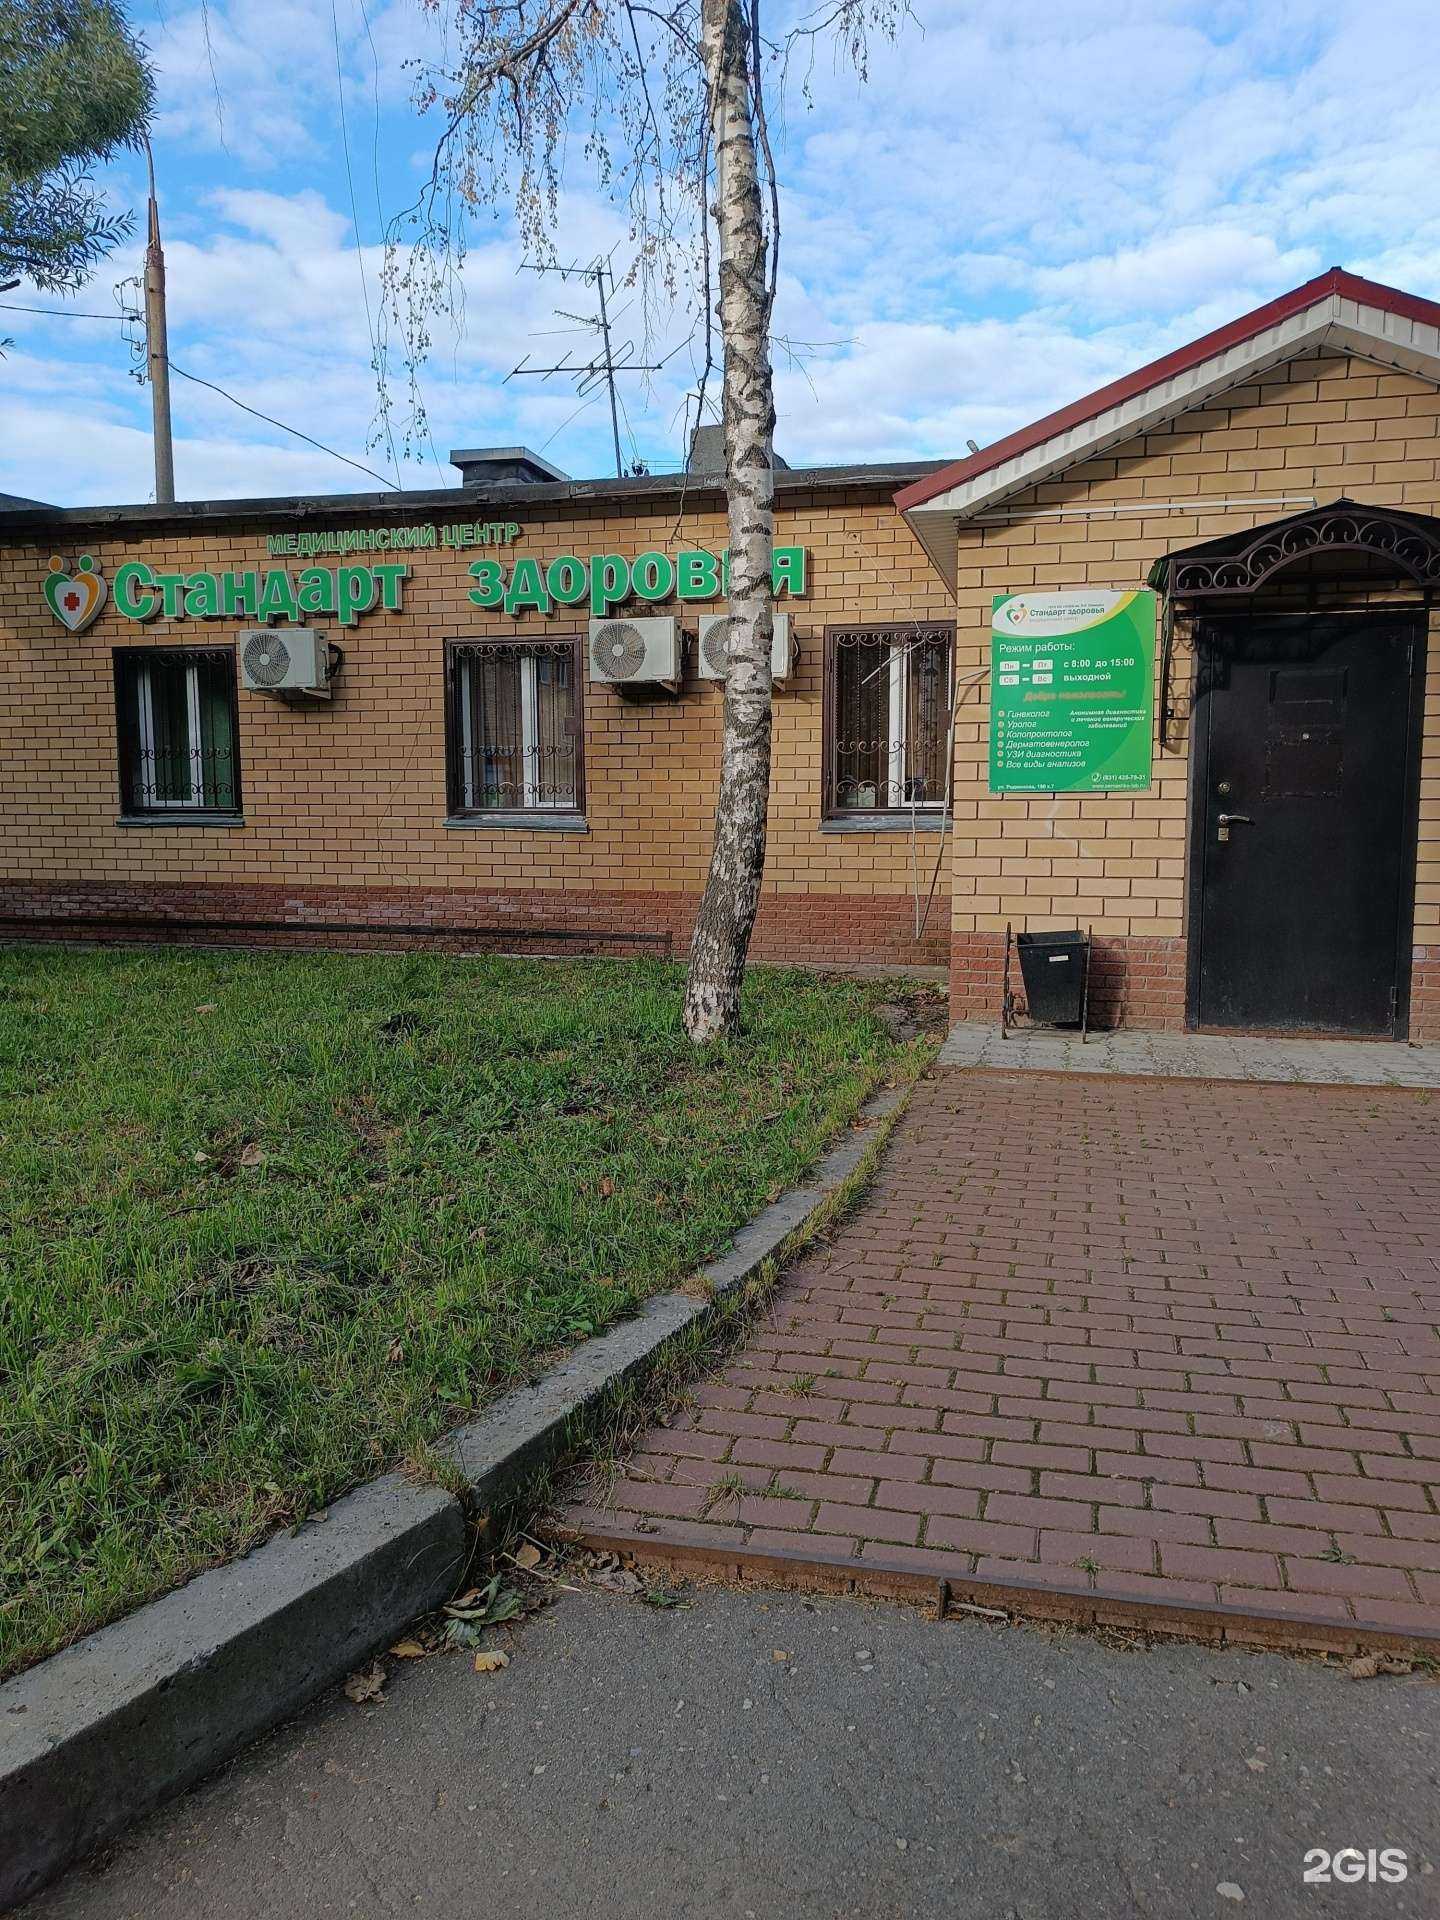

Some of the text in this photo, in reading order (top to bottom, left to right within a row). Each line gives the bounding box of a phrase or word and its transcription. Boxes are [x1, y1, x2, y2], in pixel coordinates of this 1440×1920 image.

[266, 521, 520, 557] МЕДИЦИНСКИЙ ЦЕНТР
[112, 546, 807, 626] Стандарт здоровя
[1030, 606, 1105, 618] Стандарт здоровья
[999, 642, 1076, 654] Режим работы:
[1071, 660, 1091, 668] 8:00
[1095, 661, 1107, 669] до
[1110, 658, 1135, 667] 15:00
[1063, 672, 1112, 683] выходной
[1006, 710, 1050, 718] Гинеколог
[1007, 720, 1037, 729] Уролог
[1006, 730, 1073, 739] Колопроктолог
[1005, 740, 1090, 749] Дерматовенеролог
[1006, 749, 1082, 758] УЗИ диагностика
[1006, 759, 1086, 768] Все виды анализов
